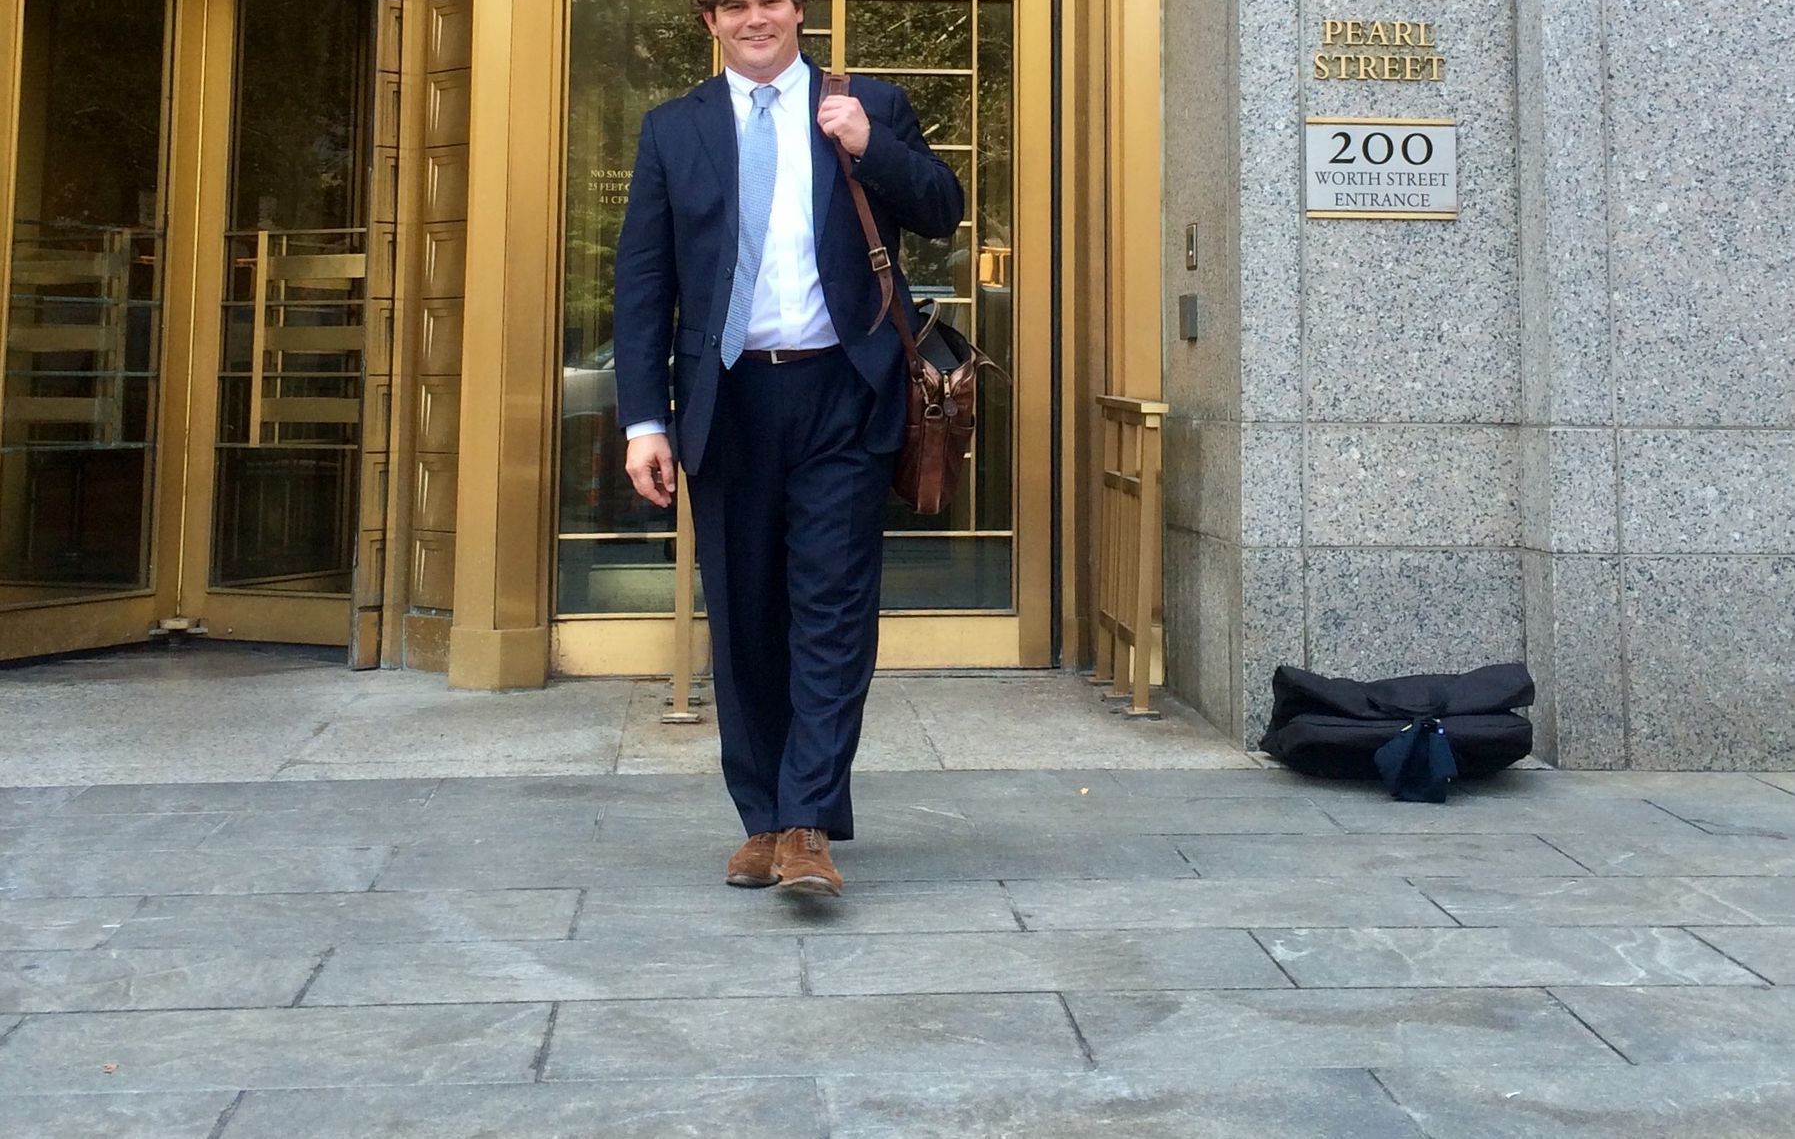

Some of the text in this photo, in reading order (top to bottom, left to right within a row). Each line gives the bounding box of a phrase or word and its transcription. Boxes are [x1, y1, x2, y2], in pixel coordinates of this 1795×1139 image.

[1322, 19, 1435, 47] PEARL
[1314, 53, 1445, 81] STREET
[1328, 131, 1433, 165] 200
[590, 169, 605, 178] NO
[1315, 171, 1449, 187] WORTH STREET
[588, 182, 598, 191] 25
[600, 182, 624, 191] FEET
[599, 195, 609, 204] 41
[1334, 192, 1431, 208] ENTRANCE
